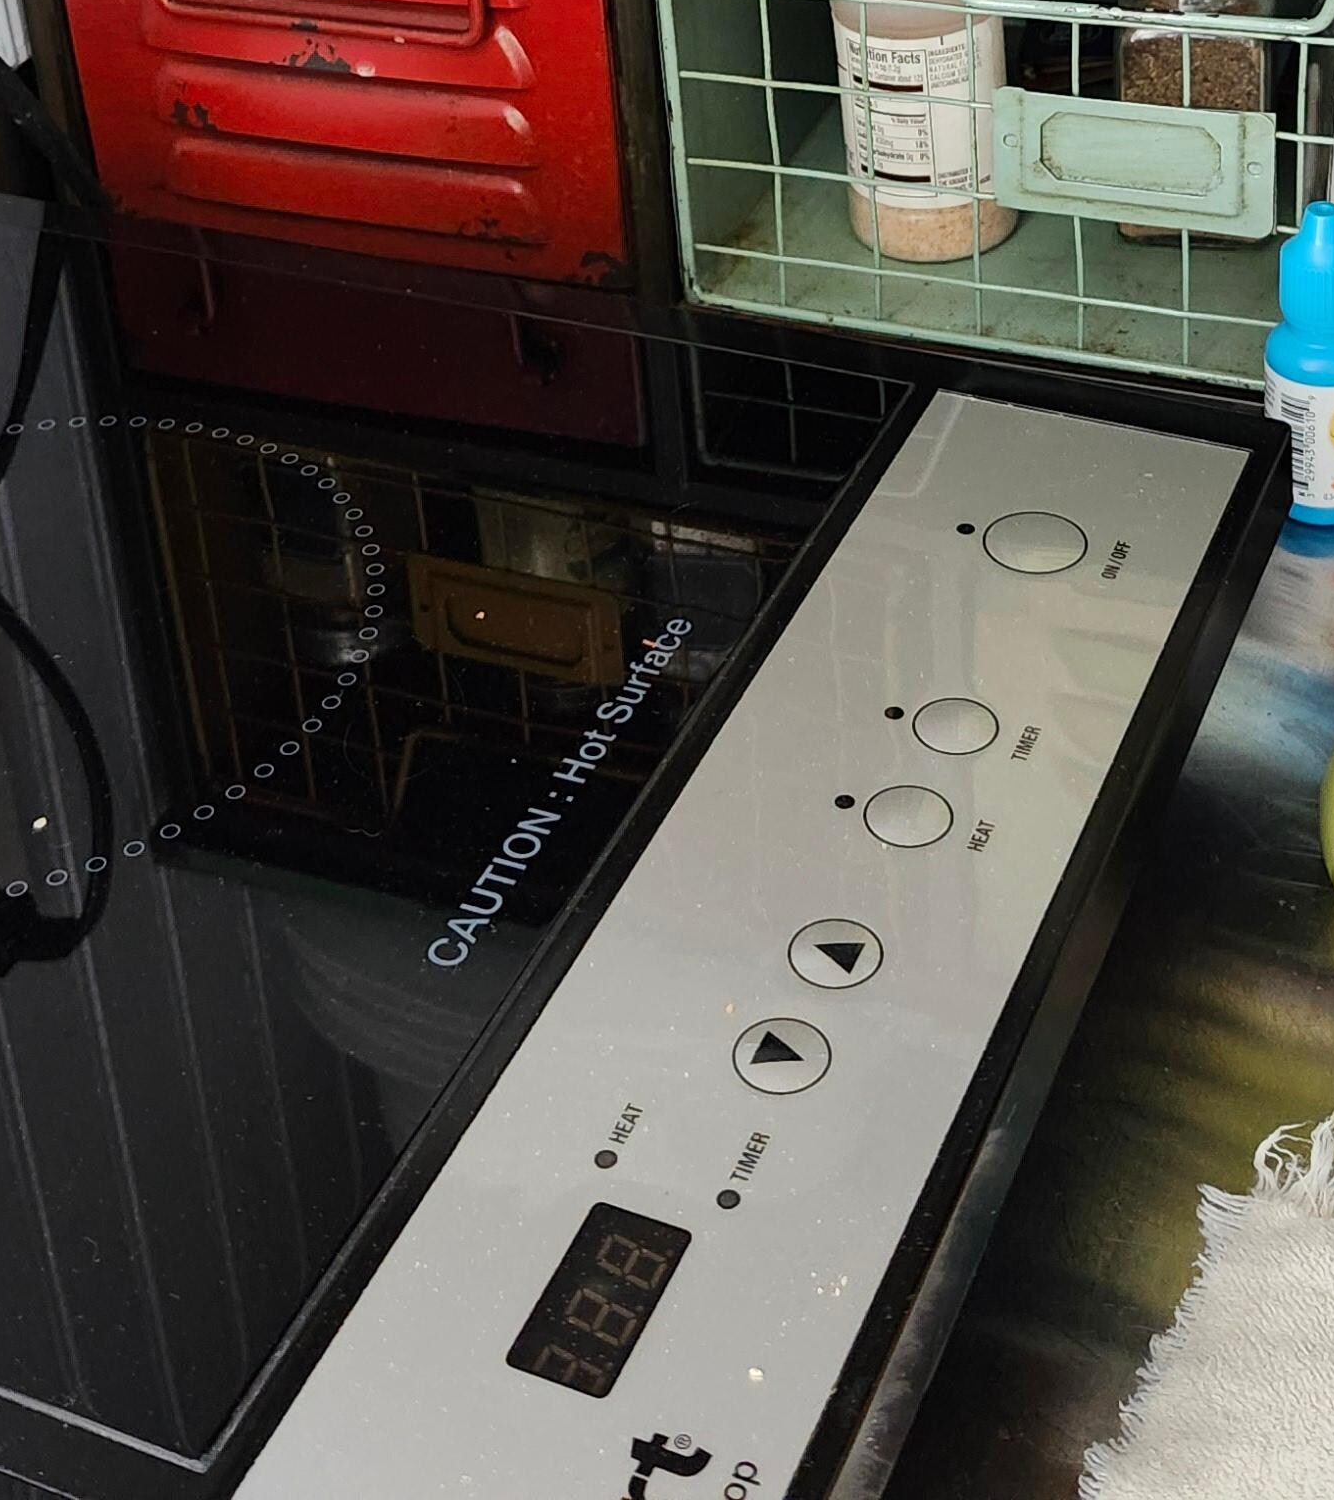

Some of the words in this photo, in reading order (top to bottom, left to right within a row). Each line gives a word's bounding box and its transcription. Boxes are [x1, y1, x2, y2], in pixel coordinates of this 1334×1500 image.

[891, 51, 921, 65] Facts
[1011, 725, 1042, 761] TIMER
[427, 807, 562, 967] CAUTION
[552, 729, 617, 784] Hot
[596, 617, 692, 724] Surface
[967, 819, 995, 852] HEAT
[608, 1102, 644, 1145] HEAT
[729, 1131, 771, 1182] TIMER
